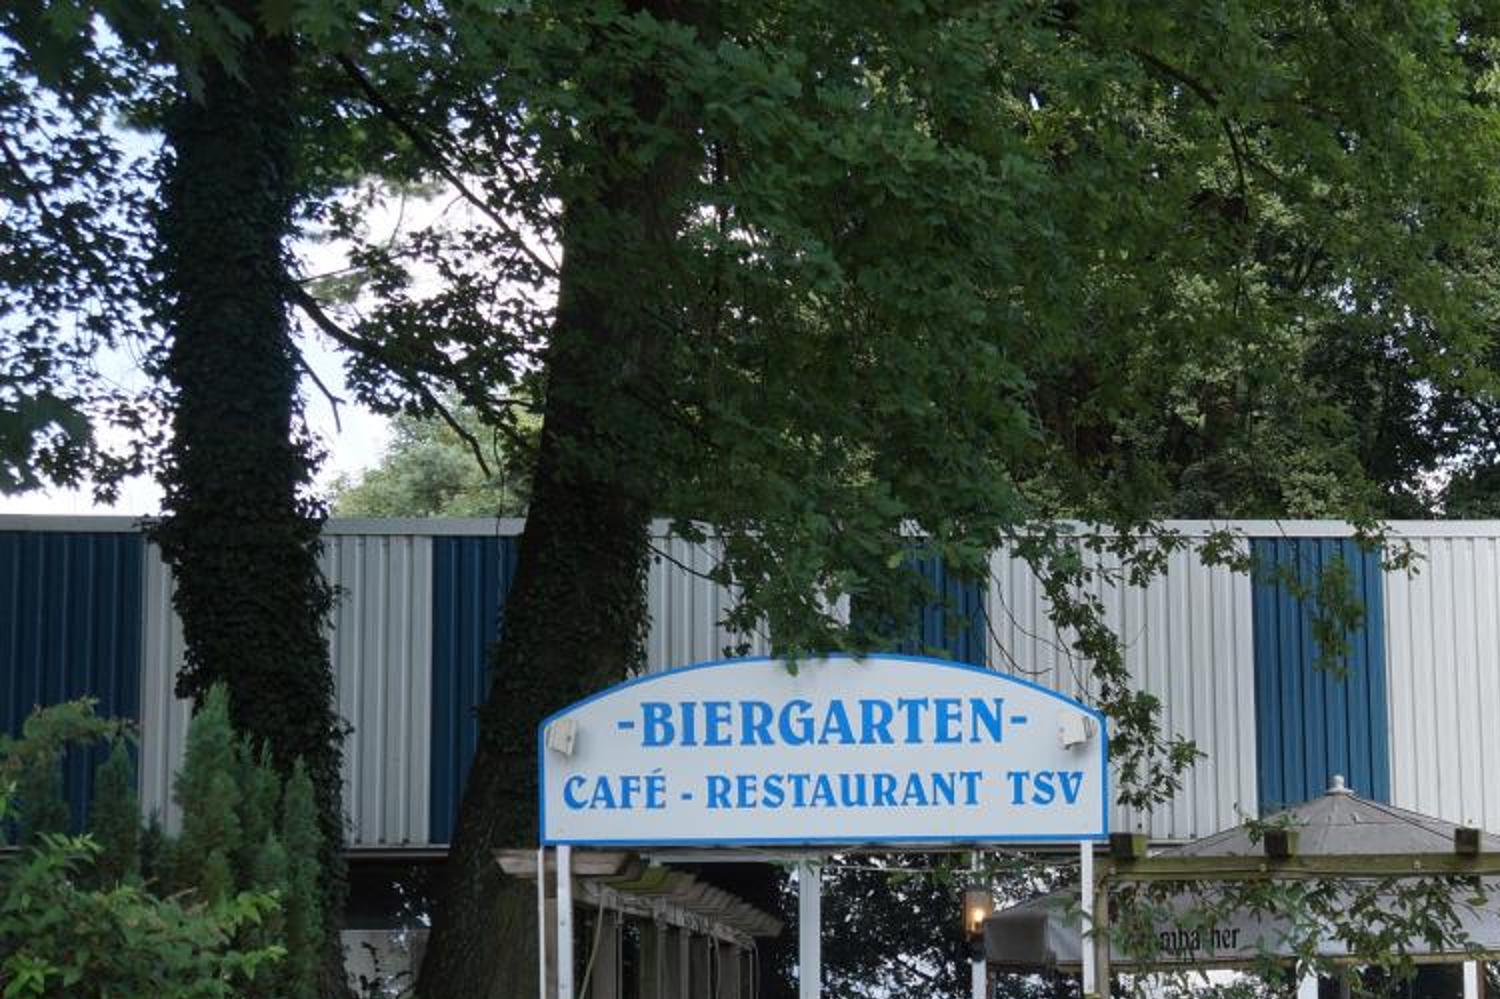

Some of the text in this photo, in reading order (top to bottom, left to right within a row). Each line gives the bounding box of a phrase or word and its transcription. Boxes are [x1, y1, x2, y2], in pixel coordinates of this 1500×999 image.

[563, 768, 666, 809] CAFÉ
[706, 771, 982, 808] RESTAURANT
[1007, 771, 1083, 805] TSV
